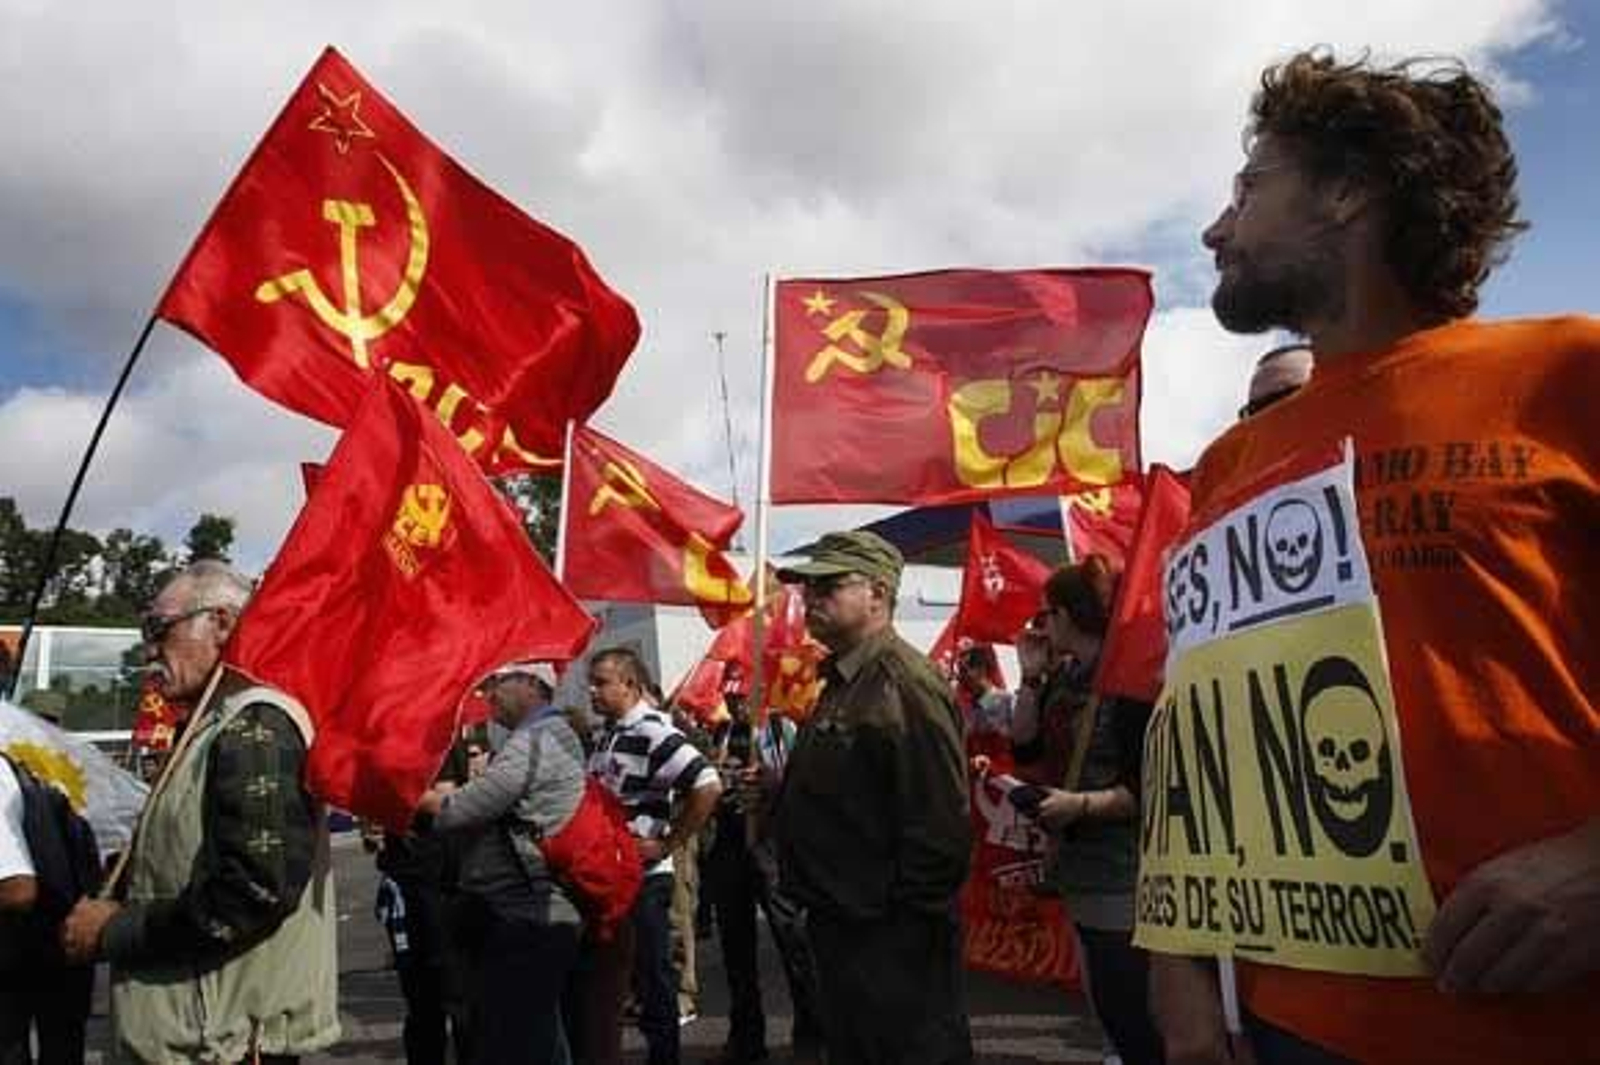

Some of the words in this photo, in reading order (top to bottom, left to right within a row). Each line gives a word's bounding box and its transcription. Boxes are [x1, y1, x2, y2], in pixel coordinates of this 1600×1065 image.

[1446, 440, 1530, 479] BAY
[1226, 485, 1353, 612] NO!
[1247, 655, 1408, 864] NO.
[1184, 875, 1222, 932] DE
[1226, 876, 1265, 935] SU
[1268, 879, 1421, 950] TERROR!
